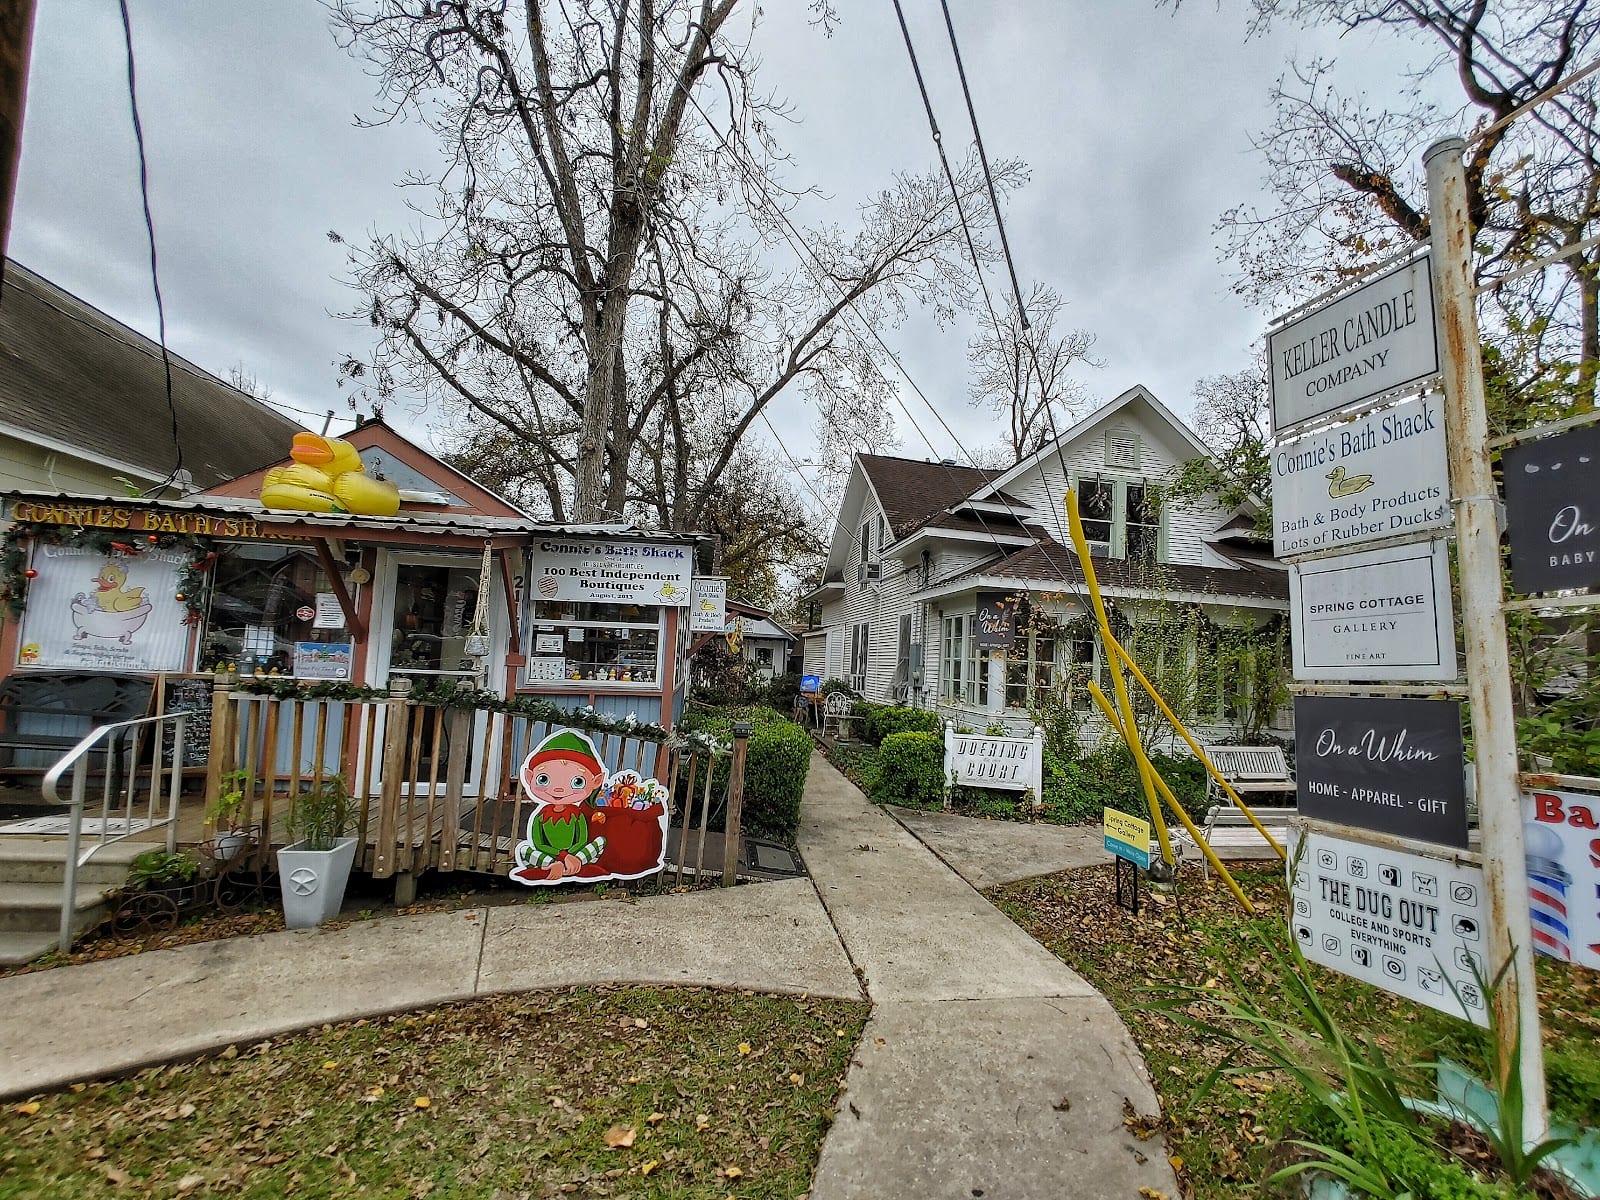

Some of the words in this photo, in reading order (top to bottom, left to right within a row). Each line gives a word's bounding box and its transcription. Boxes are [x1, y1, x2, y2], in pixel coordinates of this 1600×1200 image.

[1283, 328, 1341, 381] KELLER
[1343, 290, 1416, 352] CANDLE
[1306, 349, 1390, 397] COMPANY
[1276, 438, 1336, 477] Connie's
[1341, 423, 1377, 458] Bath
[1382, 402, 1435, 445] Shack
[143, 510, 212, 535] BATH
[1281, 516, 1309, 534] Bath
[1313, 512, 1325, 526] &
[1330, 504, 1367, 523] Body
[1371, 486, 1441, 512] Products
[1281, 535, 1309, 552] Lots
[1313, 530, 1328, 545] of
[1331, 521, 1385, 542] Rubber
[1389, 508, 1443, 530] Ducks
[1548, 505, 1596, 544] On
[540, 541, 602, 555] Connie's
[604, 544, 639, 557] Bath
[641, 546, 685, 559] Shack
[1549, 551, 1595, 567] BABY
[543, 567, 566, 576] 100
[569, 568, 598, 578] Best
[600, 569, 681, 582] Independent
[579, 579, 645, 592] Boutiques
[1309, 601, 1355, 614] SPRING
[1359, 594, 1425, 610] COTTAGE
[1333, 621, 1398, 634] GALLERY
[1345, 653, 1367, 661] FINE
[1369, 652, 1387, 660] ART
[957, 740, 1029, 760] DOERING
[1315, 728, 1344, 757] On
[1347, 744, 1361, 757] a
[1360, 728, 1440, 763] Whim
[967, 762, 1020, 780] COURT
[1308, 781, 1340, 798] HOME
[1351, 788, 1405, 809] APPAREL
[1417, 798, 1449, 816] GIFT
[1123, 820, 1144, 834] Cottage
[1319, 875, 1351, 909] THE
[1356, 885, 1393, 921] DUG
[1398, 898, 1440, 935] OUT
[1329, 908, 1368, 929] COLLEGE
[1370, 921, 1390, 935] AND
[1392, 927, 1431, 948] SPORTS
[1351, 928, 1407, 956] EVERYTHING
